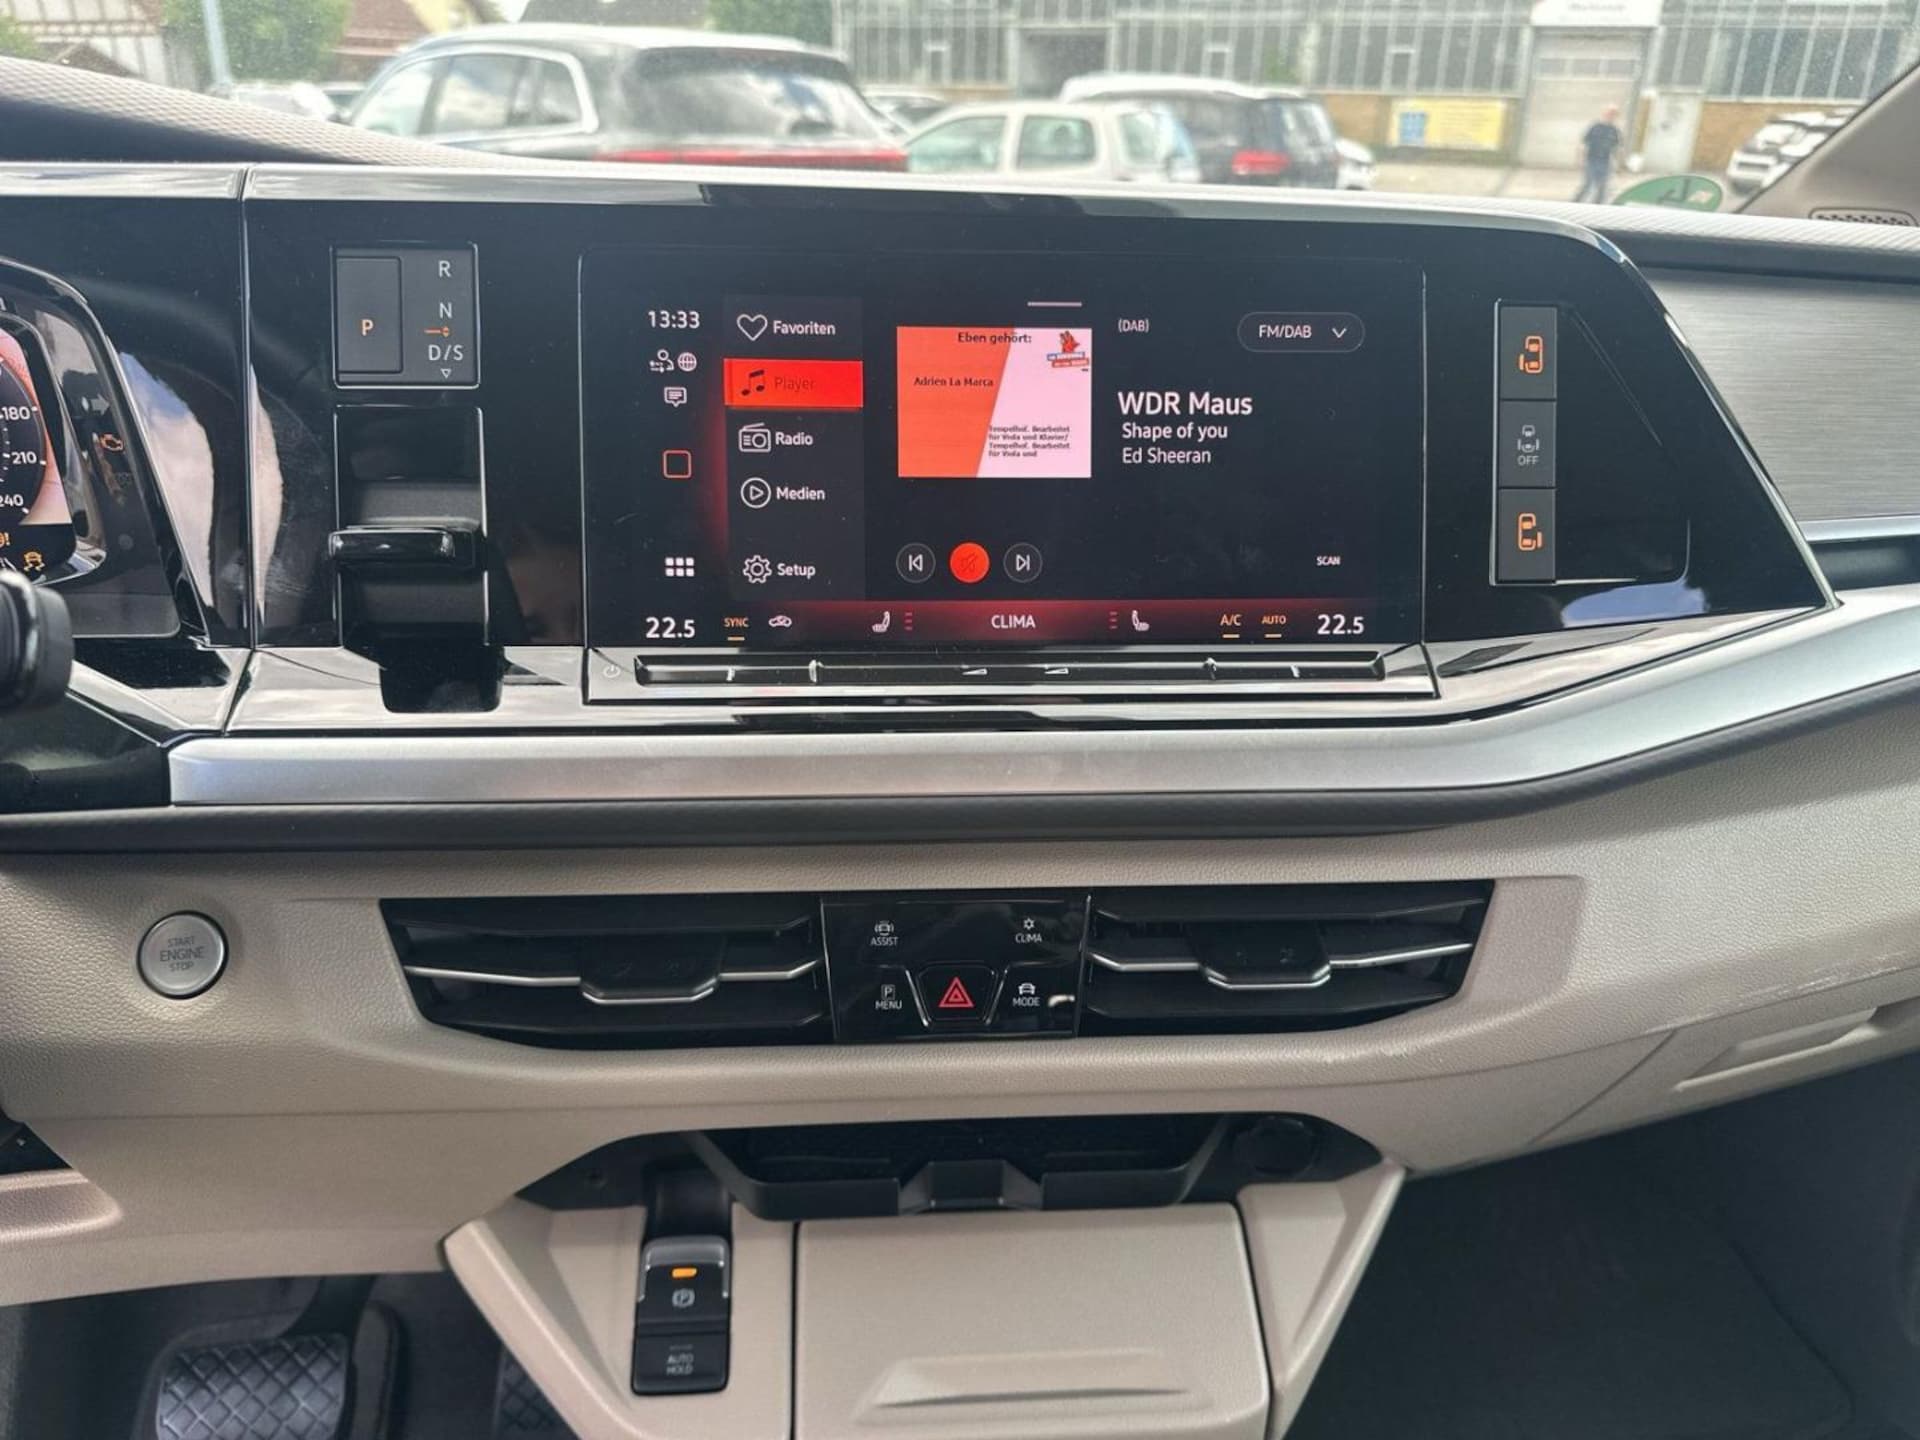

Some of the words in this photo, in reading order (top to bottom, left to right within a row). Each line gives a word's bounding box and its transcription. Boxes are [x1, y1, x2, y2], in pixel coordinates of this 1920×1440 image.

[438, 260, 451, 278] R
[439, 302, 453, 319] N
[648, 310, 700, 329] 13:33
[1117, 318, 1150, 333] (DAB)
[361, 318, 374, 337] P
[772, 319, 836, 336] Favoriten
[1258, 324, 1313, 339] FM/DAB
[957, 332, 987, 343] Eben
[989, 331, 1032, 346] gehört:
[428, 344, 464, 361] D/S
[774, 376, 816, 393] Player
[914, 376, 947, 387] Adrien
[949, 377, 961, 387] La
[1117, 391, 1181, 415] WDR
[1188, 391, 1253, 416] Maus
[3, 405, 31, 421] 180
[775, 431, 814, 446] Radio
[1122, 421, 1173, 442] Shape
[1176, 421, 1194, 439] of
[1197, 425, 1228, 442] you
[12, 451, 37, 465] 210
[1122, 446, 1143, 464] Ed
[1147, 446, 1212, 464] Sheeran
[1517, 455, 1539, 466] OFF
[775, 486, 826, 501] Medien
[1316, 555, 1341, 566] SCAN
[777, 562, 816, 579] Setup
[724, 617, 749, 628] SYNC
[991, 614, 1036, 629] CLIMA
[1220, 613, 1242, 627] A/C
[1261, 615, 1287, 625] AUTO
[1317, 614, 1364, 635] 22.5
[645, 617, 696, 639] 22.5
[870, 936, 899, 947] ASSIST
[160, 946, 205, 961] ENGINE
[875, 1000, 902, 1010] MENU
[1012, 997, 1040, 1007] MODE
